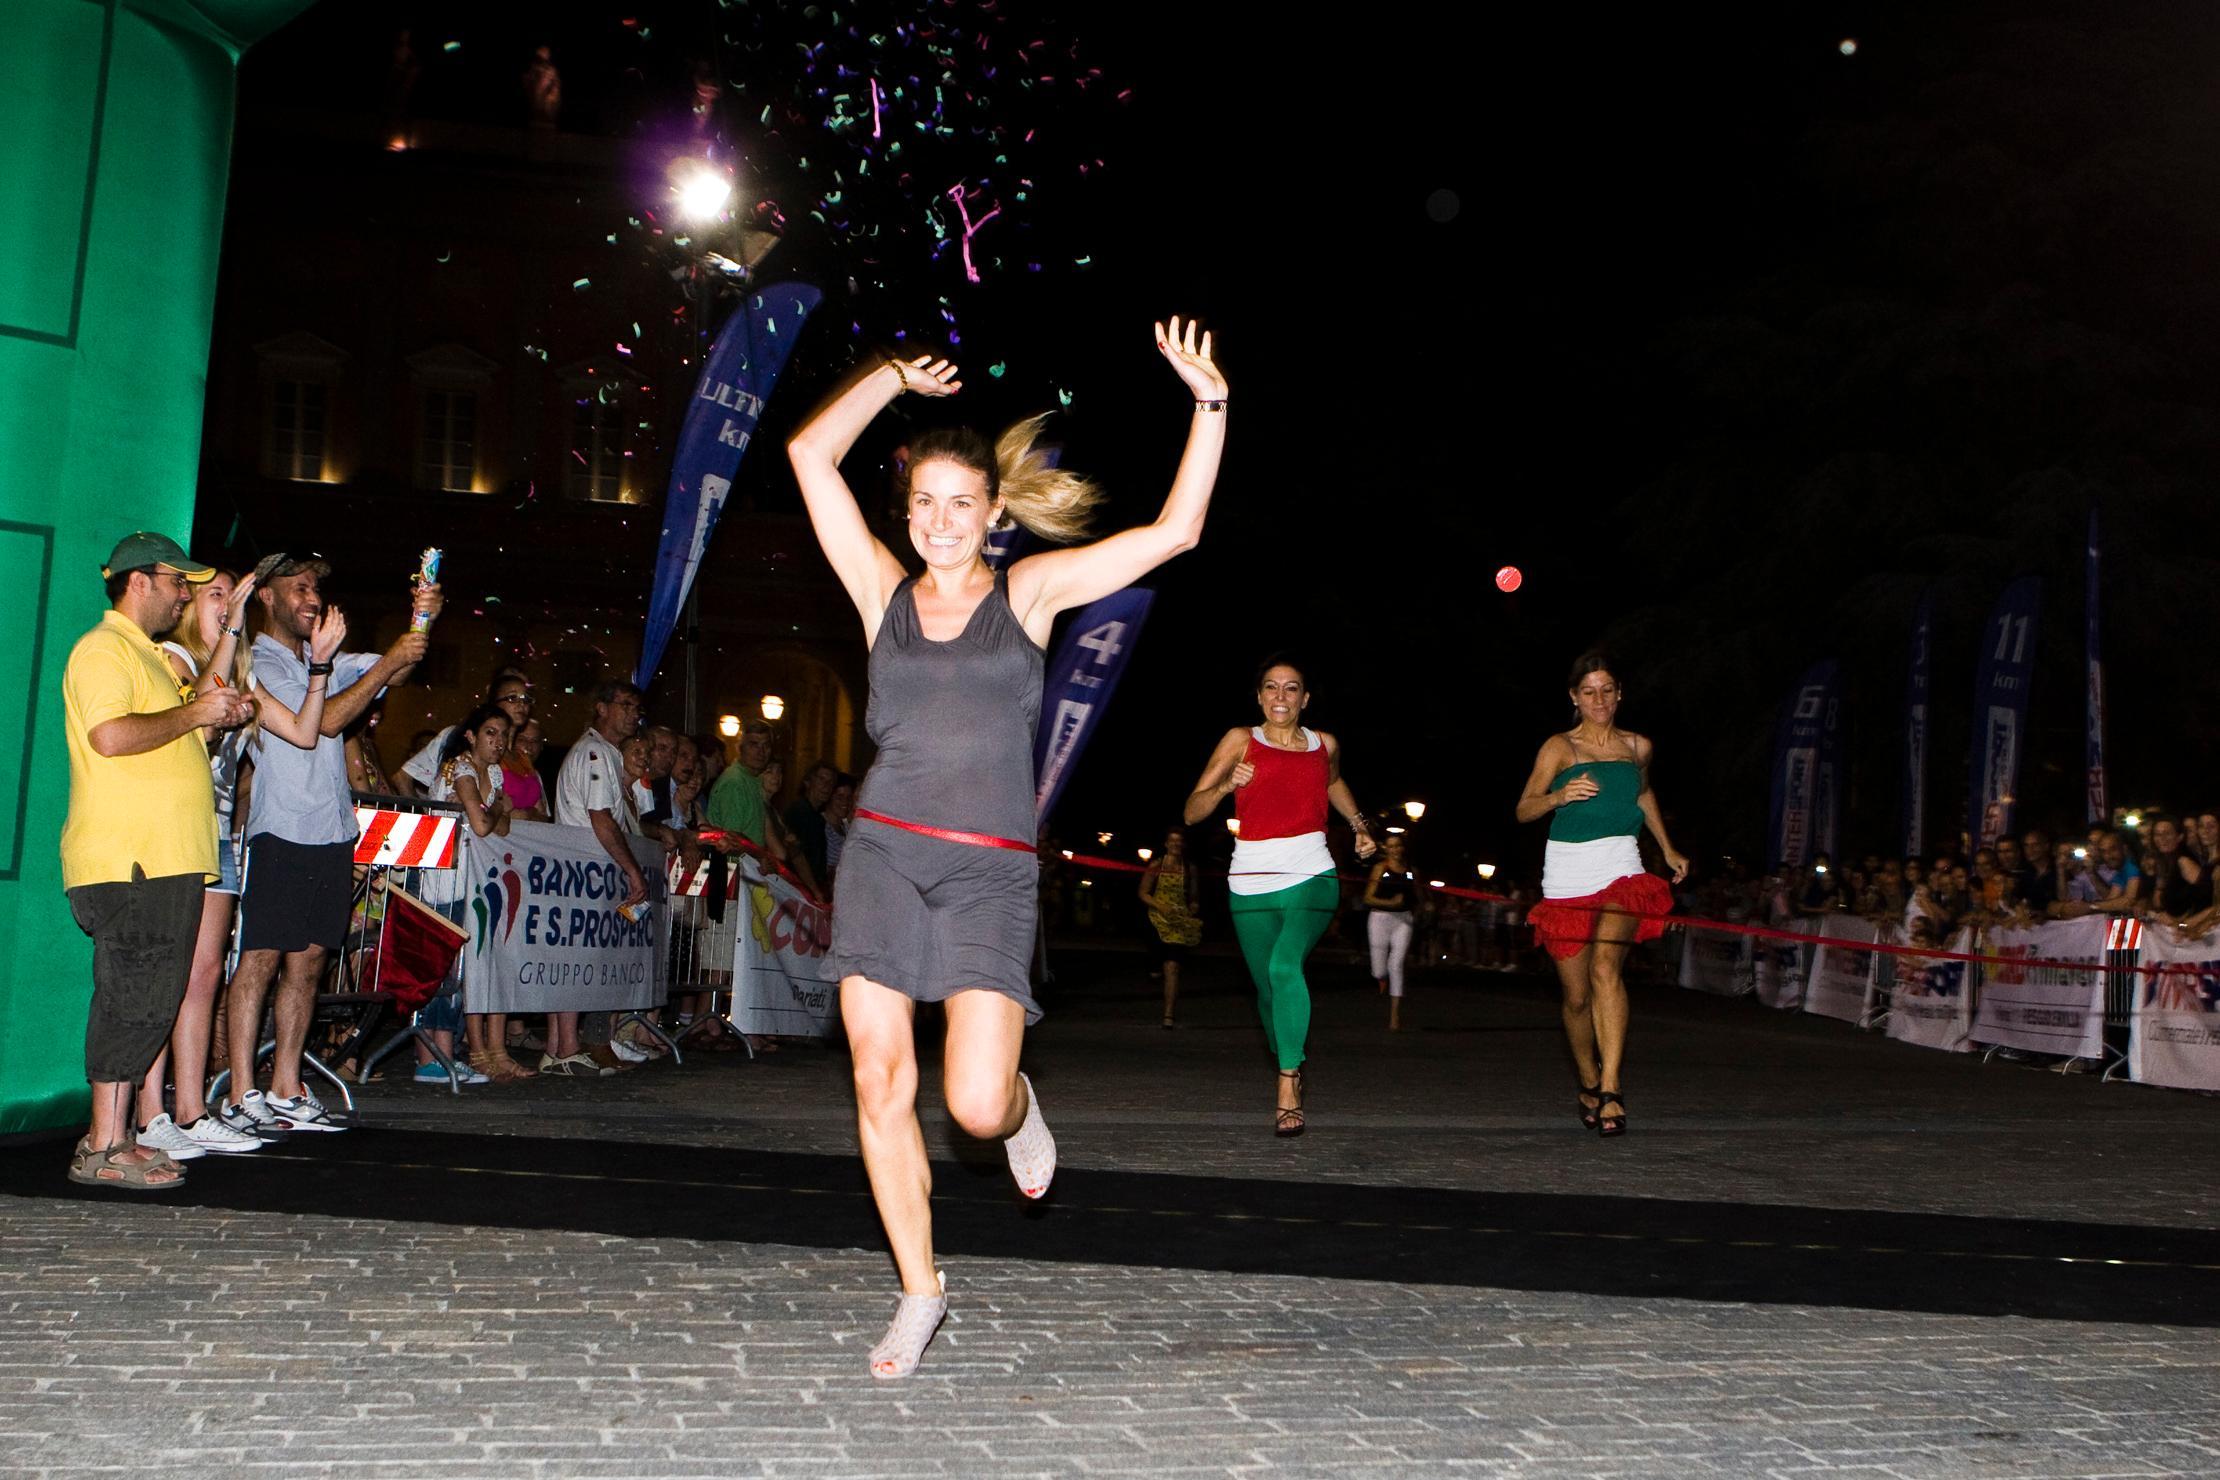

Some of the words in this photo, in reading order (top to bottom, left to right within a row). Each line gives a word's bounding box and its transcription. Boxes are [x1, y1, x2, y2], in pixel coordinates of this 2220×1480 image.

[1076, 620, 1129, 666] 4
[1994, 612, 2029, 664] 11
[1992, 671, 2018, 690] km
[1792, 684, 1826, 719] 6
[528, 855, 617, 901] BANCO
[525, 905, 541, 945] E
[519, 961, 594, 986] GRUPPO
[600, 962, 645, 986] BANCO
